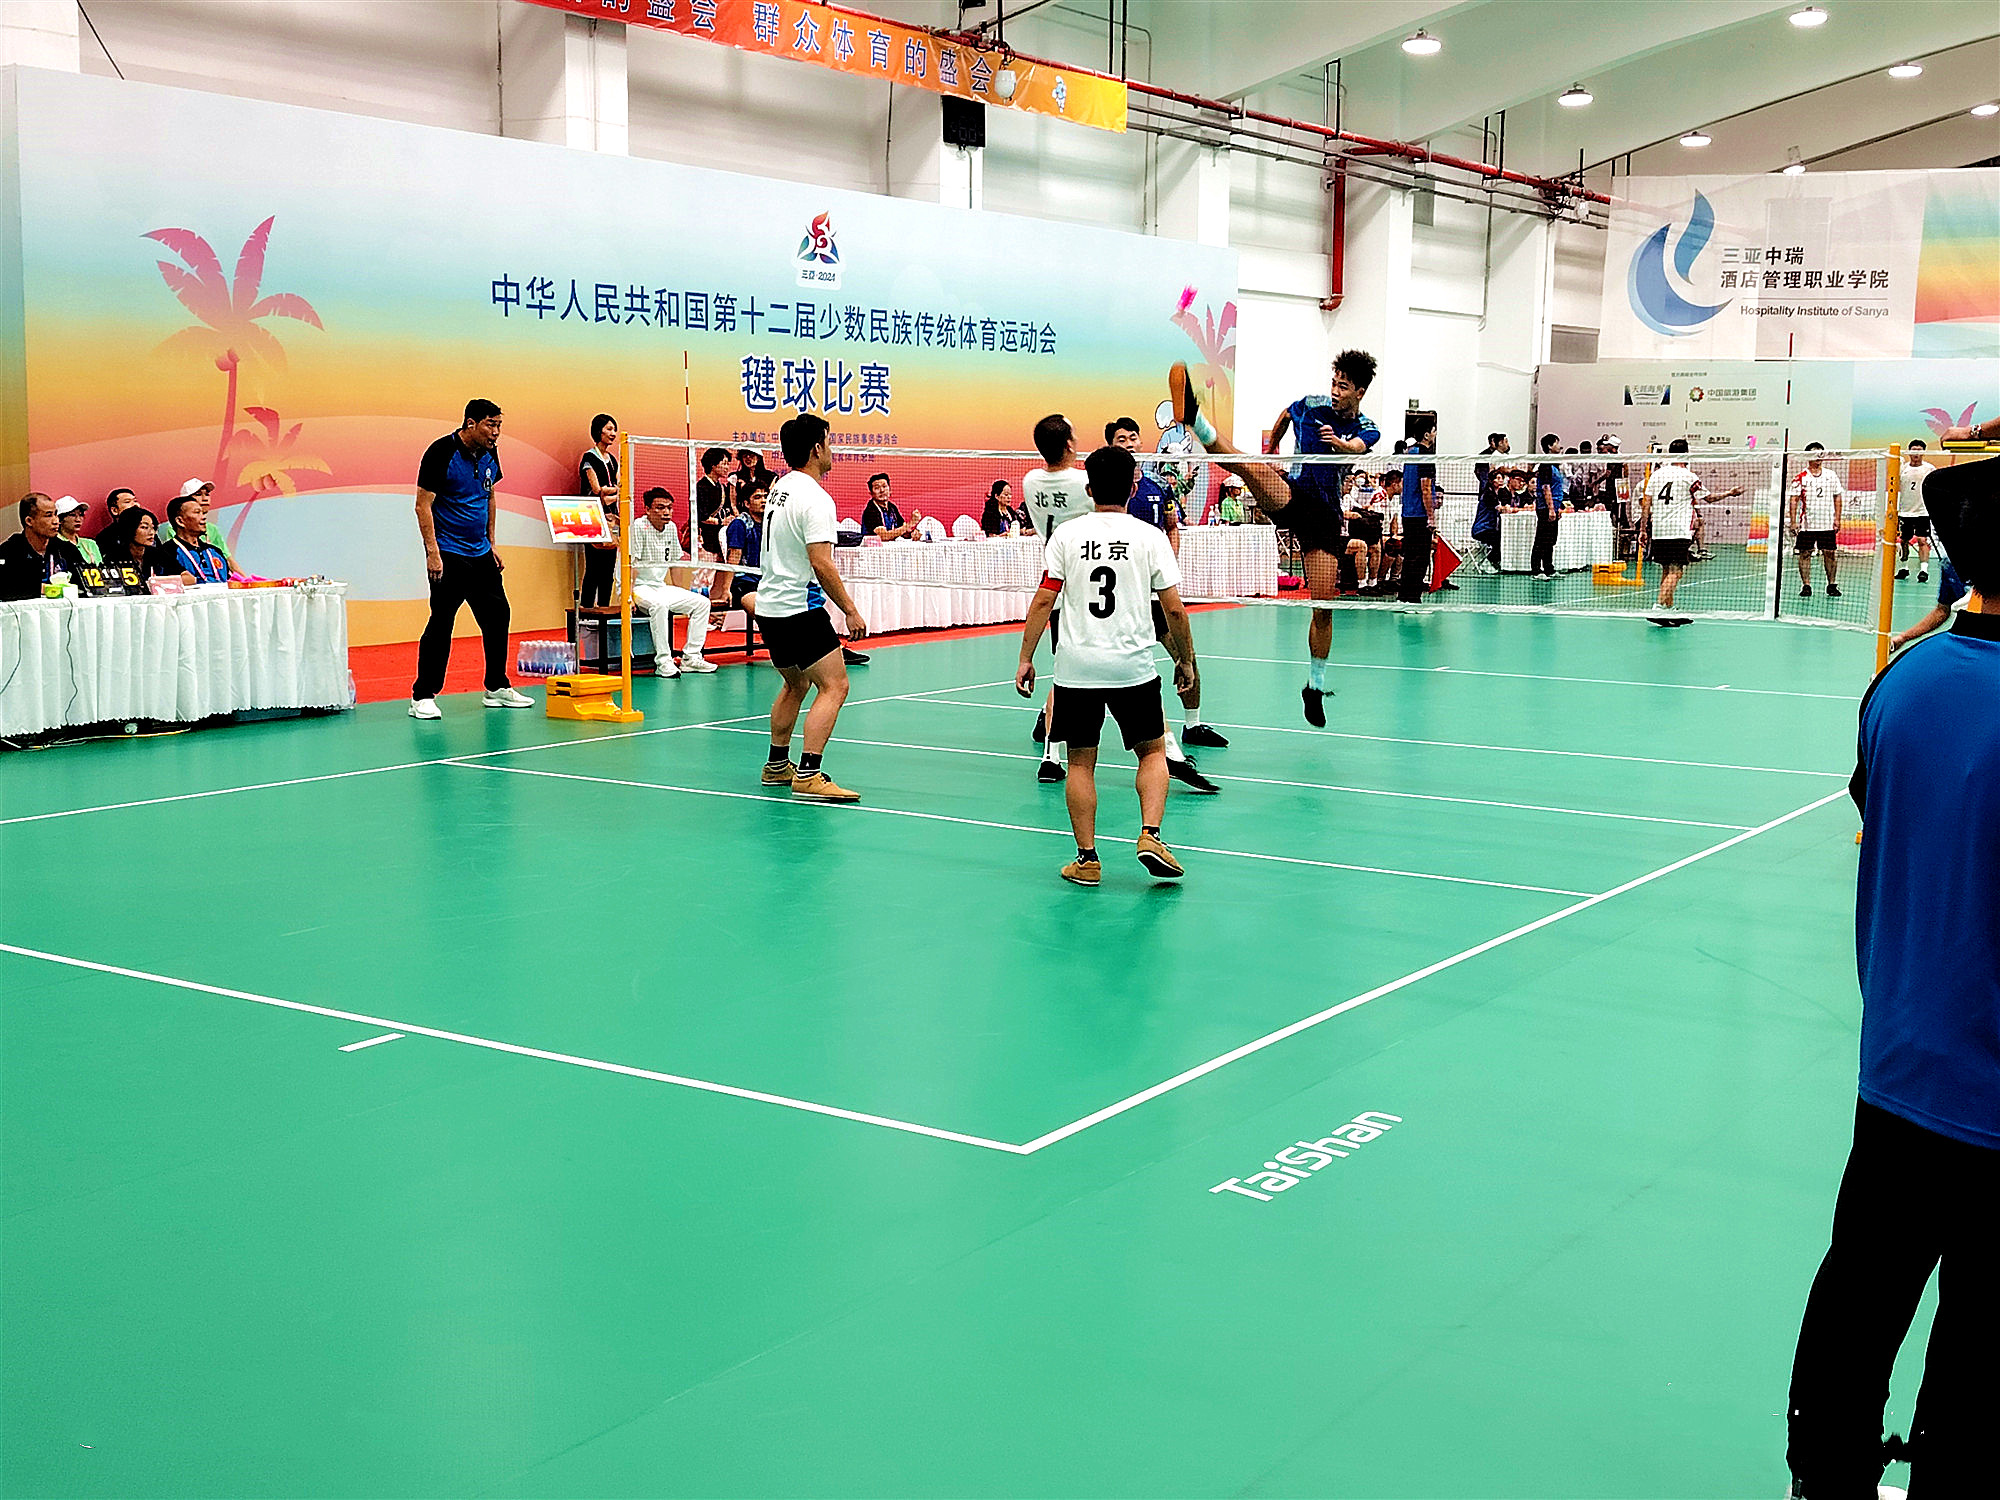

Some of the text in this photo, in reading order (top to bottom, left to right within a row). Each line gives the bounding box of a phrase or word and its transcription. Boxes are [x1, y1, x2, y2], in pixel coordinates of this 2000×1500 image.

[752, 2, 993, 94] 群众体育的盛会
[1721, 246, 1804, 265] 三亚中瑞
[1720, 270, 1889, 289] 酒店管理职业学院
[491, 273, 1057, 355] 中华人民共和国第十二届少数民族传统体育运动会
[1741, 305, 1889, 318] Hospitality Institute of Sanya
[741, 355, 890, 414] 毽球比赛
[1657, 481, 1674, 505] 4
[1816, 486, 1824, 498] 2
[1911, 481, 1917, 491] 2
[769, 488, 790, 507] 北京
[1035, 491, 1068, 508] 北京
[560, 511, 593, 525] 江西
[766, 510, 774, 552] 1
[1080, 540, 1129, 561] 北京
[82, 568, 105, 587] 12
[121, 568, 139, 586] 5
[1088, 565, 1117, 619] 3
[1208, 1110, 1403, 1202] TaiShan
